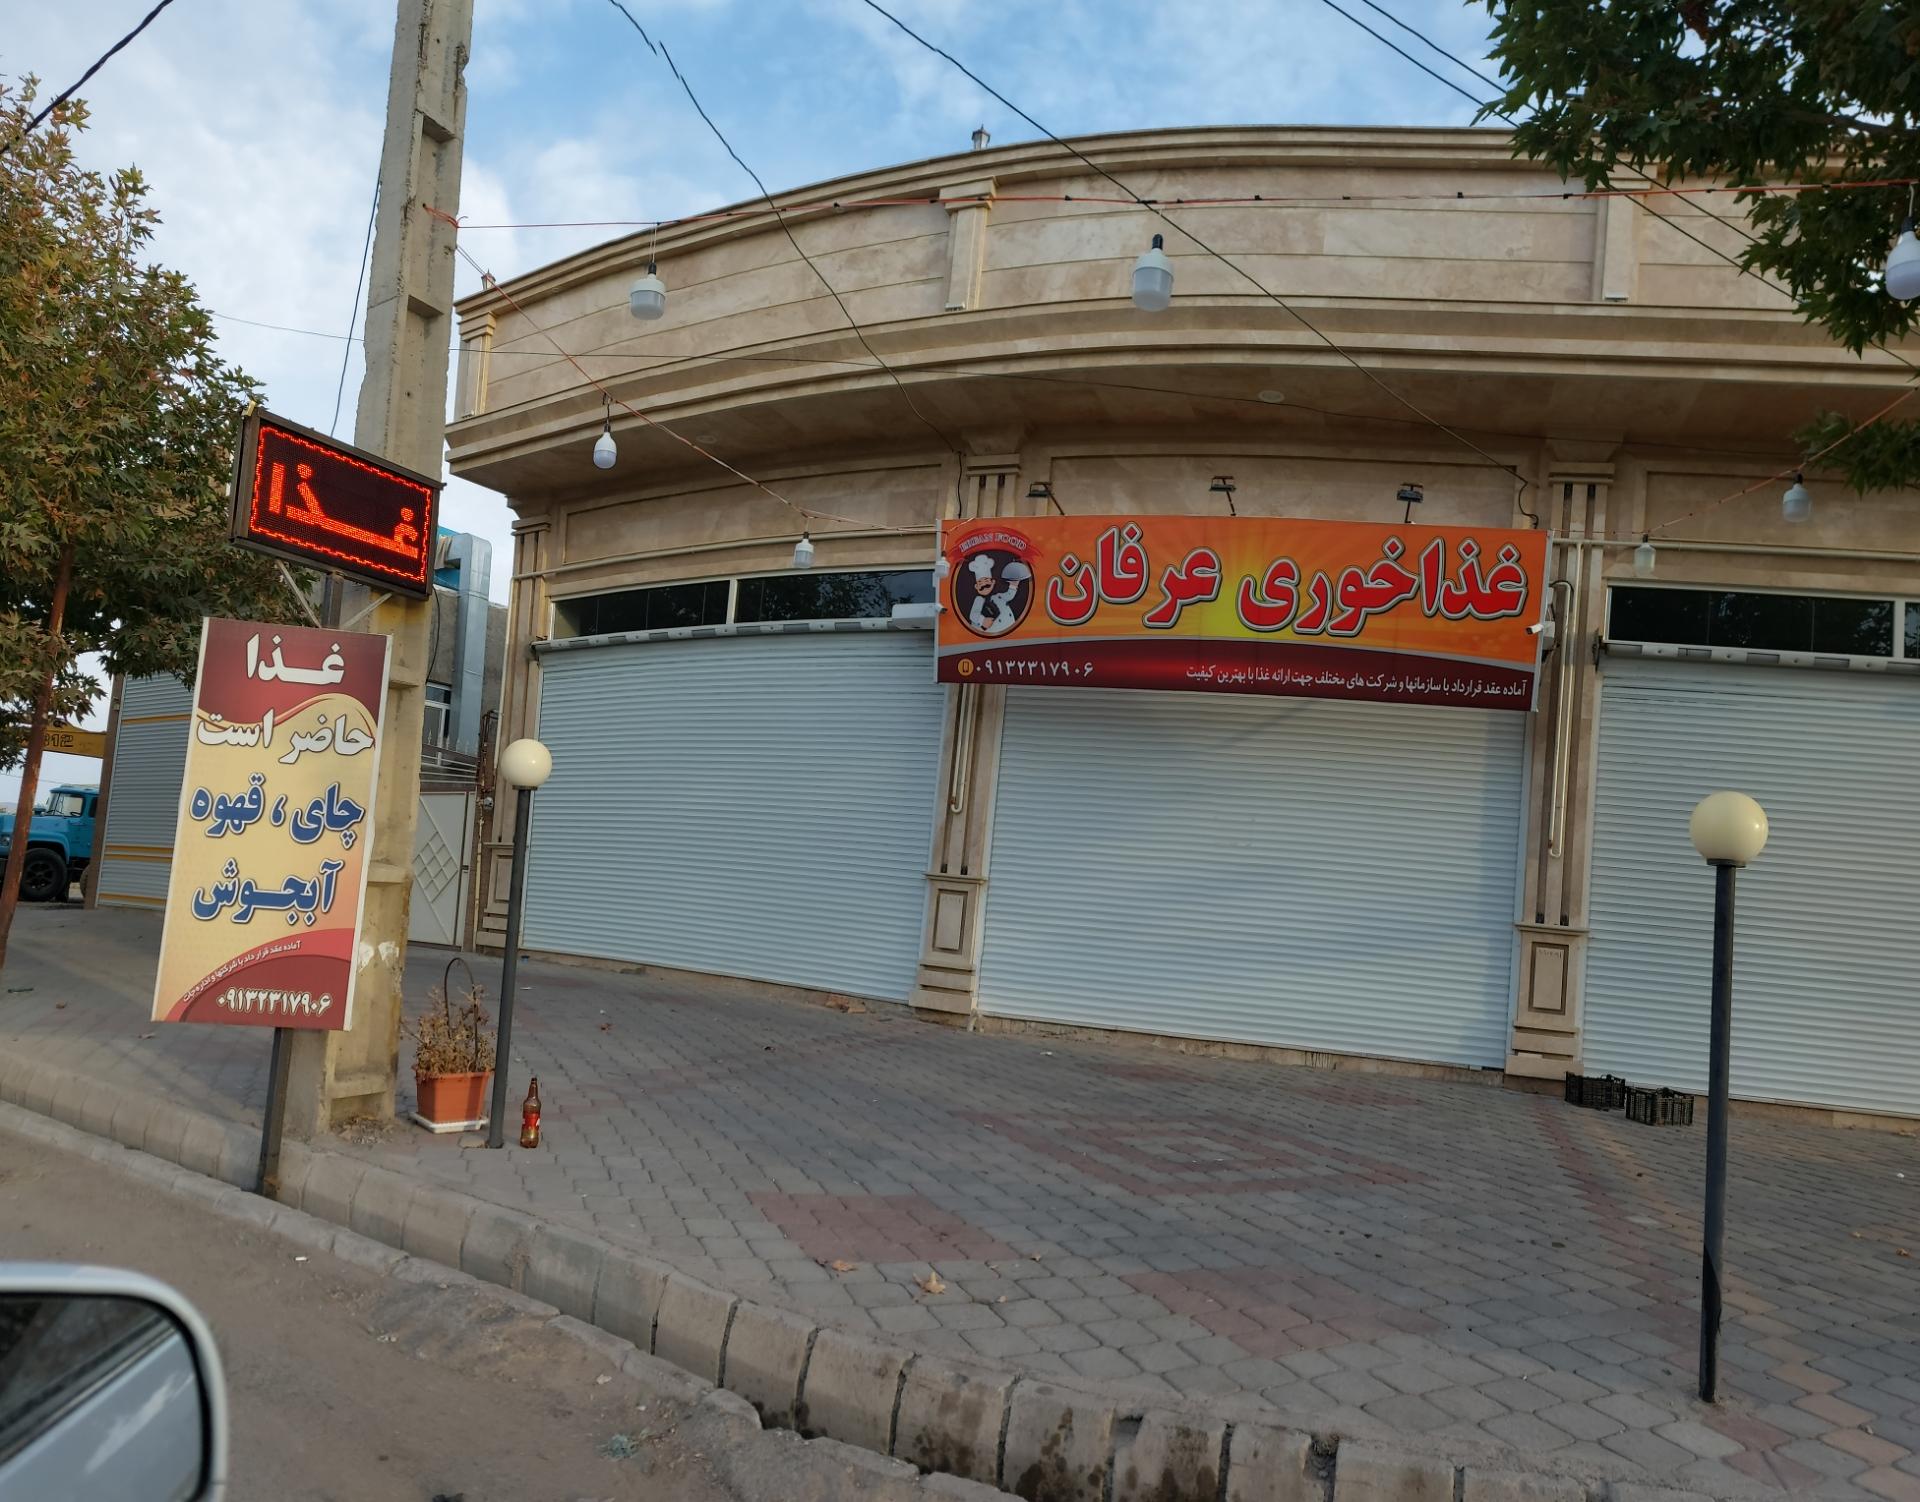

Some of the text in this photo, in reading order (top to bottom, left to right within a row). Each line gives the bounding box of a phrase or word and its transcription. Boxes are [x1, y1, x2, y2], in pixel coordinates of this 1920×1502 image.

[268, 462, 418, 559] غذا
[994, 532, 1026, 551] FOOD
[1045, 520, 1528, 637] غذاخوری عرفان
[245, 632, 346, 686] غذا
[976, 659, 1094, 677] ۰۹۱۳۲۳۱۷۹۰۶
[1186, 664, 1216, 682] کیفیت
[1217, 668, 1246, 684] بهترین
[1247, 666, 1254, 685] با
[1255, 667, 1270, 681] غذا
[1291, 671, 1313, 687] جهت
[1315, 671, 1345, 685] مختلف
[1405, 675, 1441, 694] سازمانها
[1442, 677, 1450, 696] با
[1451, 678, 1482, 698] قرارداد
[1483, 681, 1501, 696] عقد
[1502, 679, 1528, 697] آماده
[196, 708, 375, 765] حاضر است
[190, 772, 266, 839] قهوه
[289, 782, 365, 848] چای
[191, 857, 344, 926] آبجوش
[283, 940, 301, 951] آماده
[216, 987, 333, 1017] ۰۹۱۳۲۳۱۷۹۰۶
